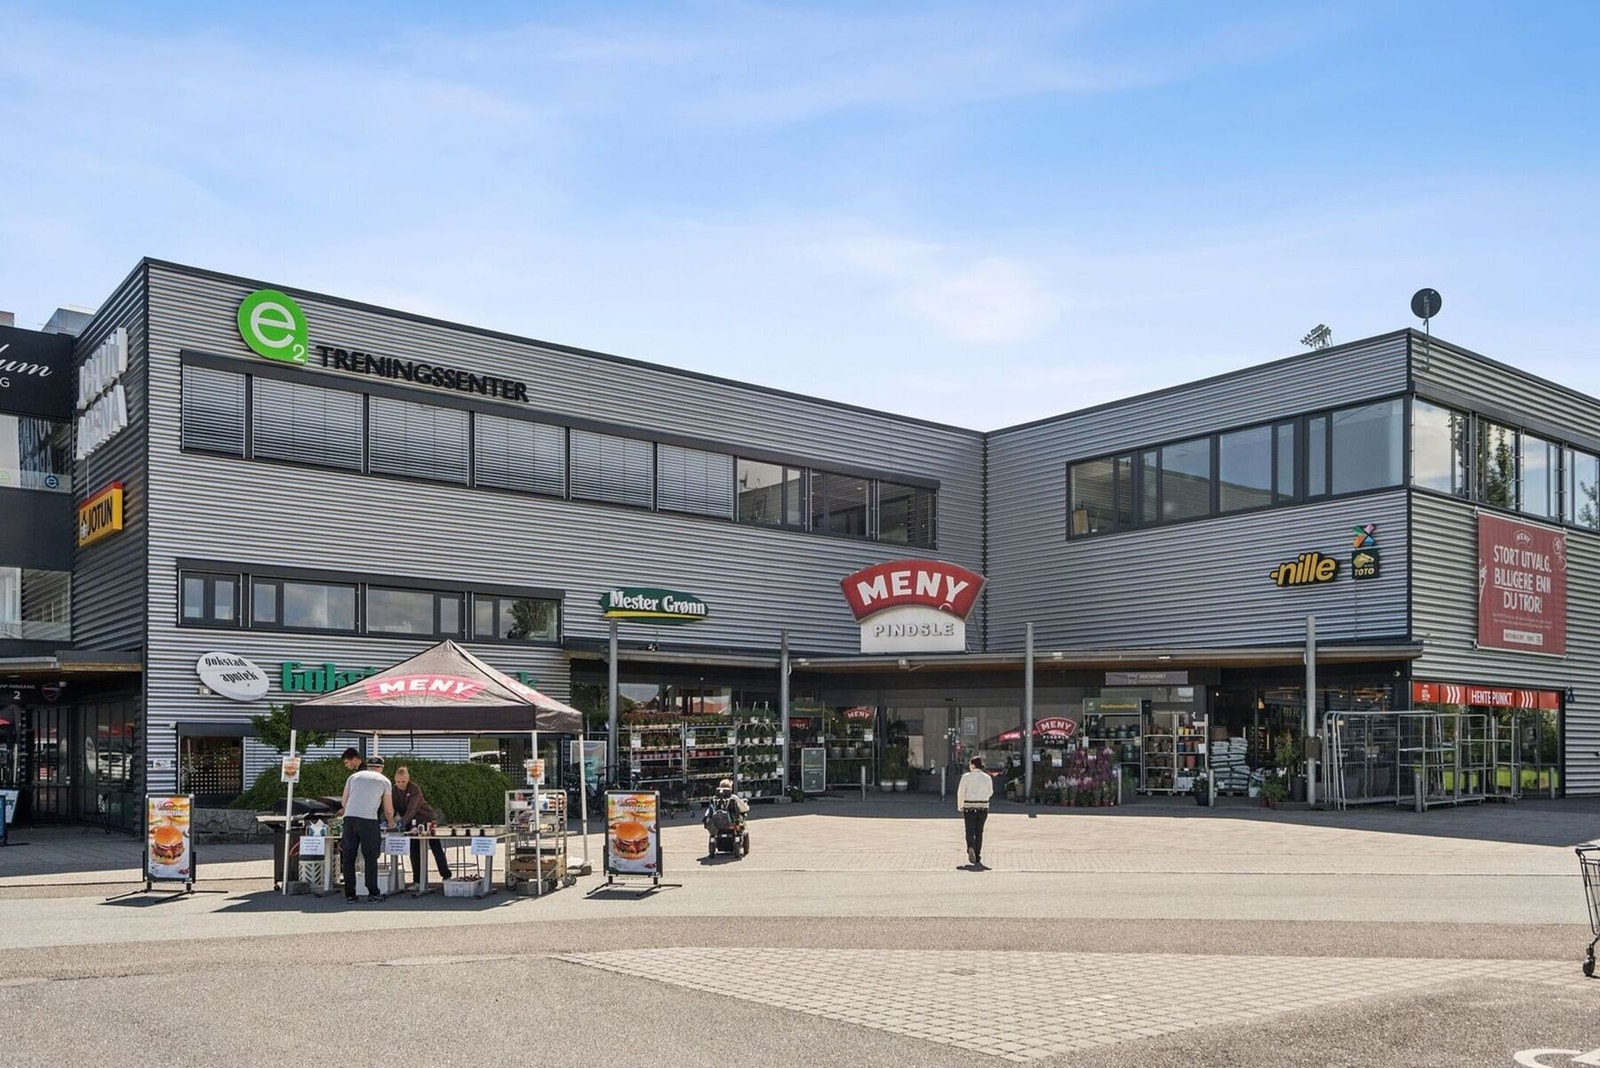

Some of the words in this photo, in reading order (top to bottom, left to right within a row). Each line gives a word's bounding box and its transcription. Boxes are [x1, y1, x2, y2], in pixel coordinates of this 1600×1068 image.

[315, 345, 530, 402] TRENINGSSENTER
[87, 496, 113, 537] JOTUN
[1493, 544, 1520, 566] STORT
[1521, 551, 1552, 573] UTVALG.
[1354, 567, 1375, 577] TOTO
[1494, 567, 1534, 591] BILLIGERE
[1535, 575, 1551, 594] ENN
[856, 570, 969, 606] MENY
[609, 590, 659, 611] Mester
[662, 595, 706, 615] Grønn
[1503, 591, 1518, 610] DU
[873, 622, 955, 639] PINDSLE
[219, 669, 260, 684] apotek
[13, 690, 21, 700] 2
[378, 678, 475, 695] MENY
[1471, 690, 1491, 705] HENTE
[1491, 691, 1513, 706] PUNKT
[847, 710, 871, 719] MENY
[1041, 720, 1072, 731] MENY
